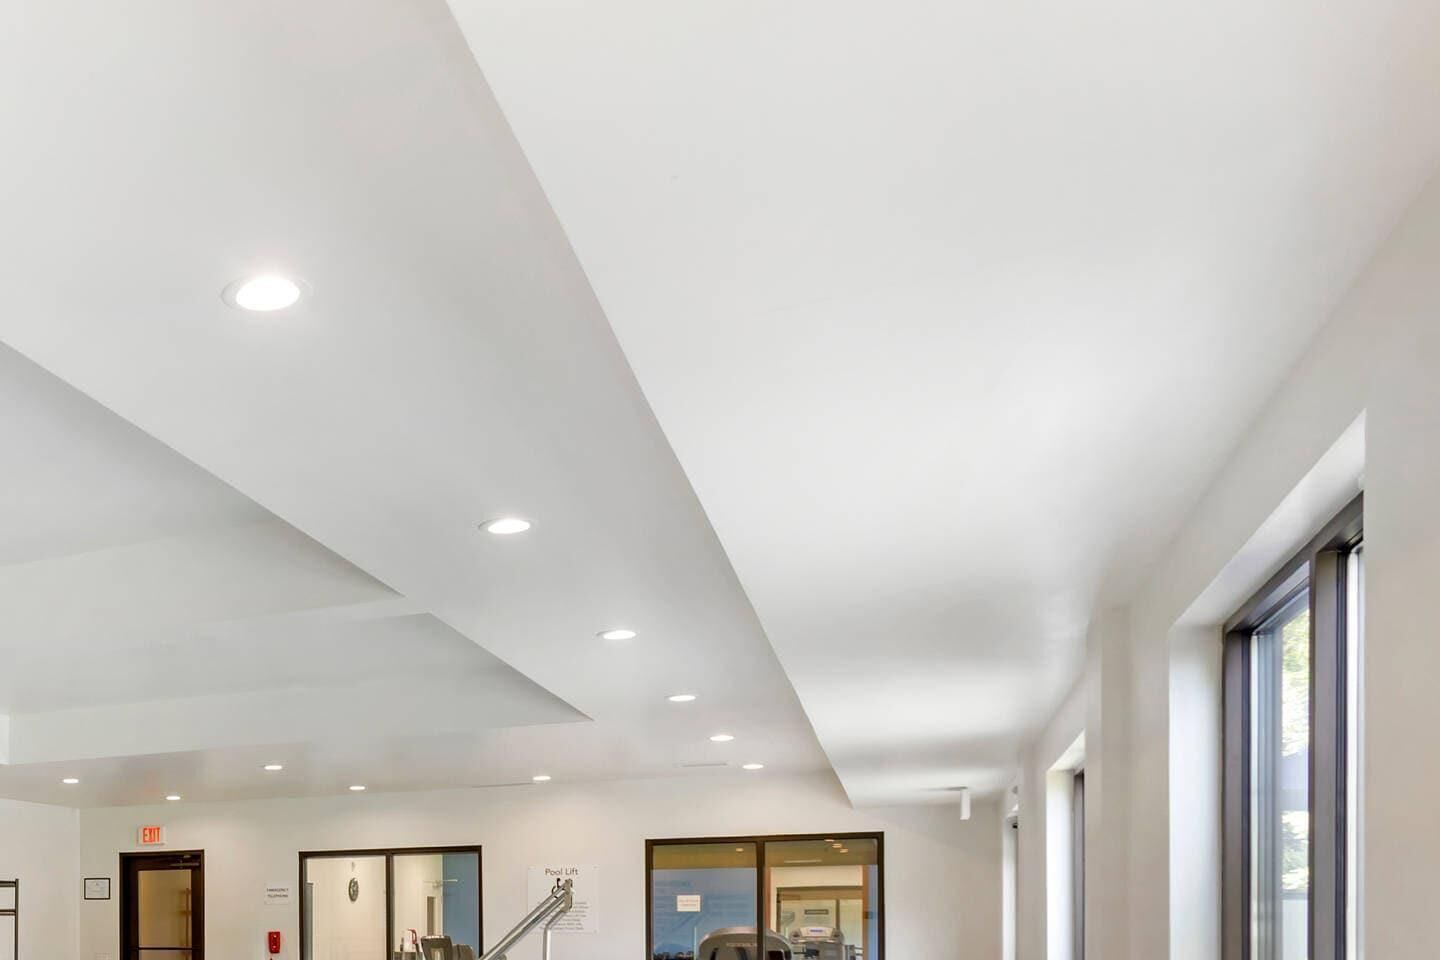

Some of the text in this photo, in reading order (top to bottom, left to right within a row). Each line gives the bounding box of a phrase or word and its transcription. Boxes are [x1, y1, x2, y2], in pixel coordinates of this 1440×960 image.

[142, 827, 161, 843] EXIT
[545, 867, 579, 876] Pool Lift
